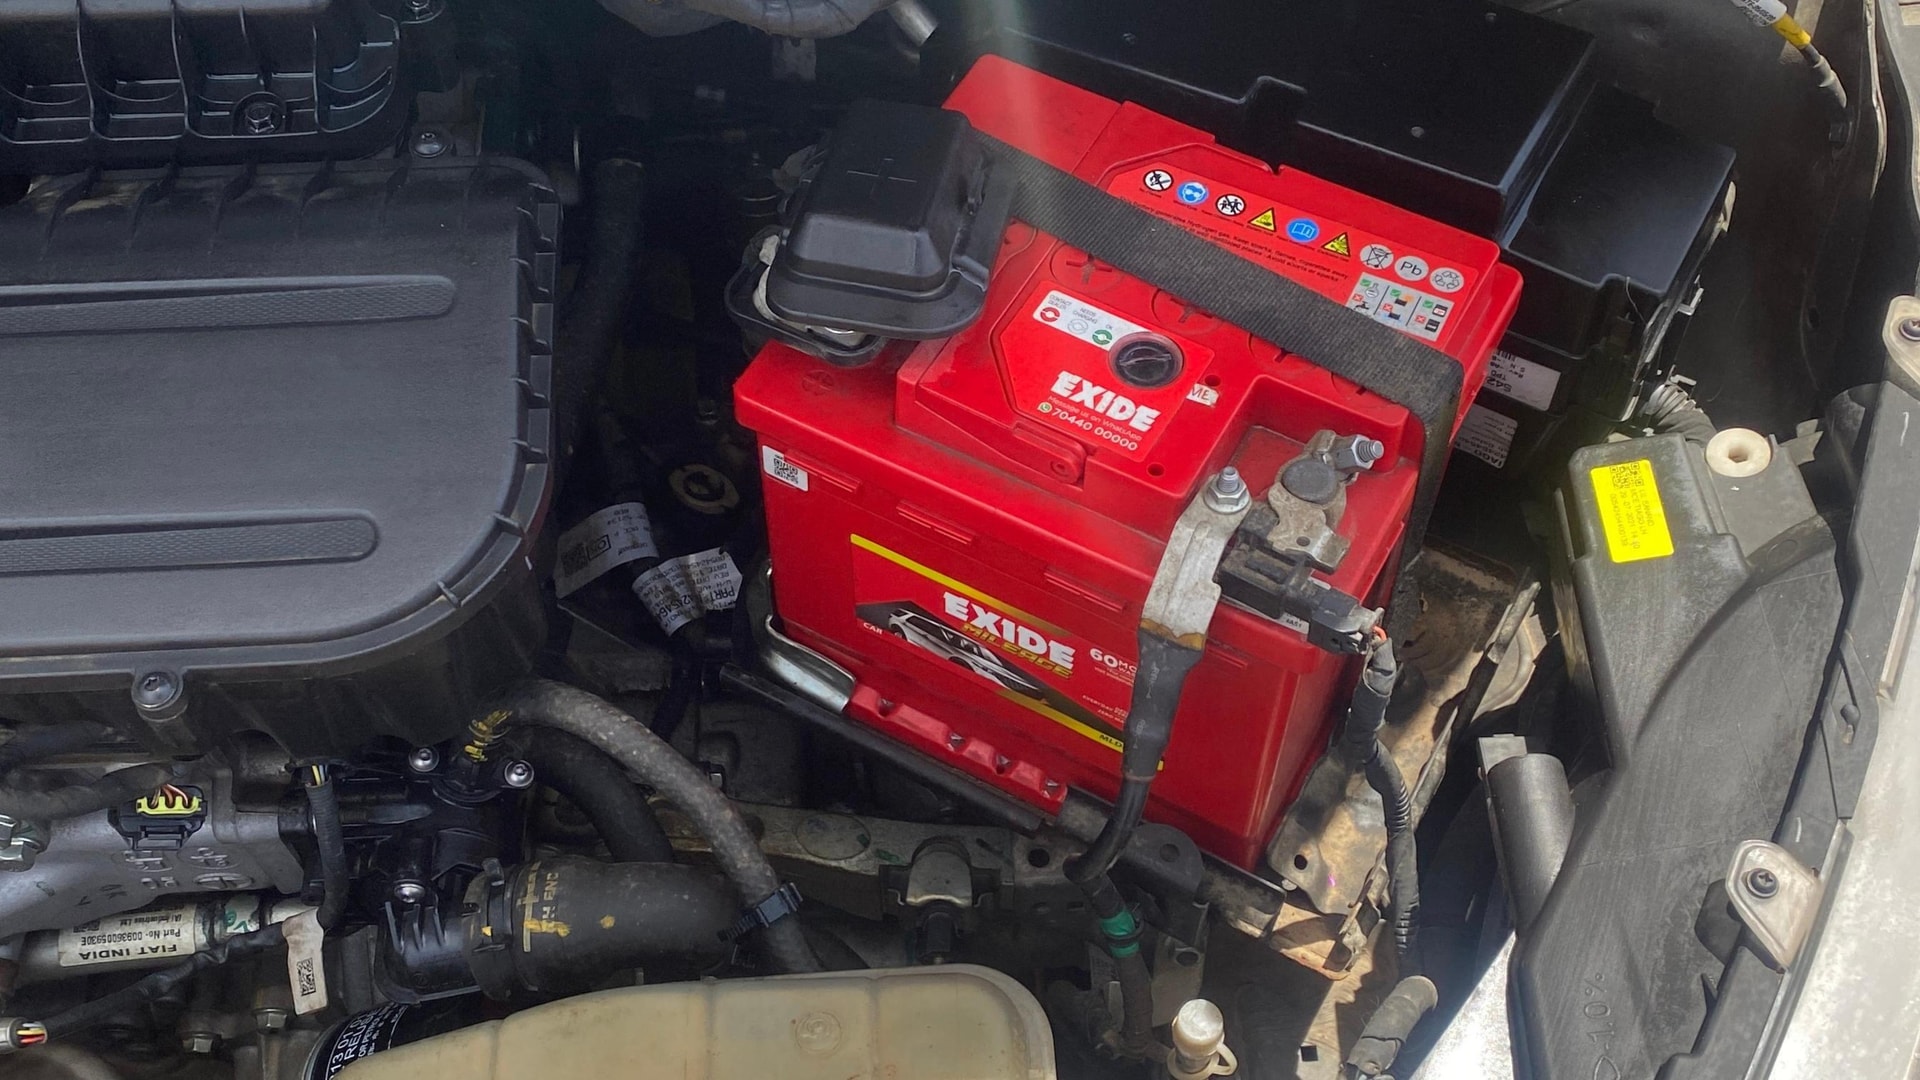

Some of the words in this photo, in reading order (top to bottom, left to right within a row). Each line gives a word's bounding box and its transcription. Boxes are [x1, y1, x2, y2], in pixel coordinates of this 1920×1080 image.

[1399, 259, 1423, 277] Pb
[1049, 294, 1072, 306] CONTACT
[1072, 309, 1097, 324] CHARGING
[1079, 306, 1096, 317] NEEDS
[1050, 369, 1161, 432] EXIDE
[1047, 395, 1080, 414] Message
[1079, 409, 1089, 418] us
[1090, 415, 1102, 423] on
[1101, 419, 1142, 442] WhatsApp
[1051, 407, 1093, 431] 70440
[1093, 425, 1138, 452] 00000
[707, 585, 735, 602] PART
[861, 621, 884, 635] CAR
[944, 590, 1078, 668] EXIDE
[960, 622, 1074, 680] MILEAGE
[1088, 646, 1119, 668] 60
[163, 928, 180, 938] Part
[78, 948, 129, 960] INDIA
[137, 944, 176, 954] FIAT
